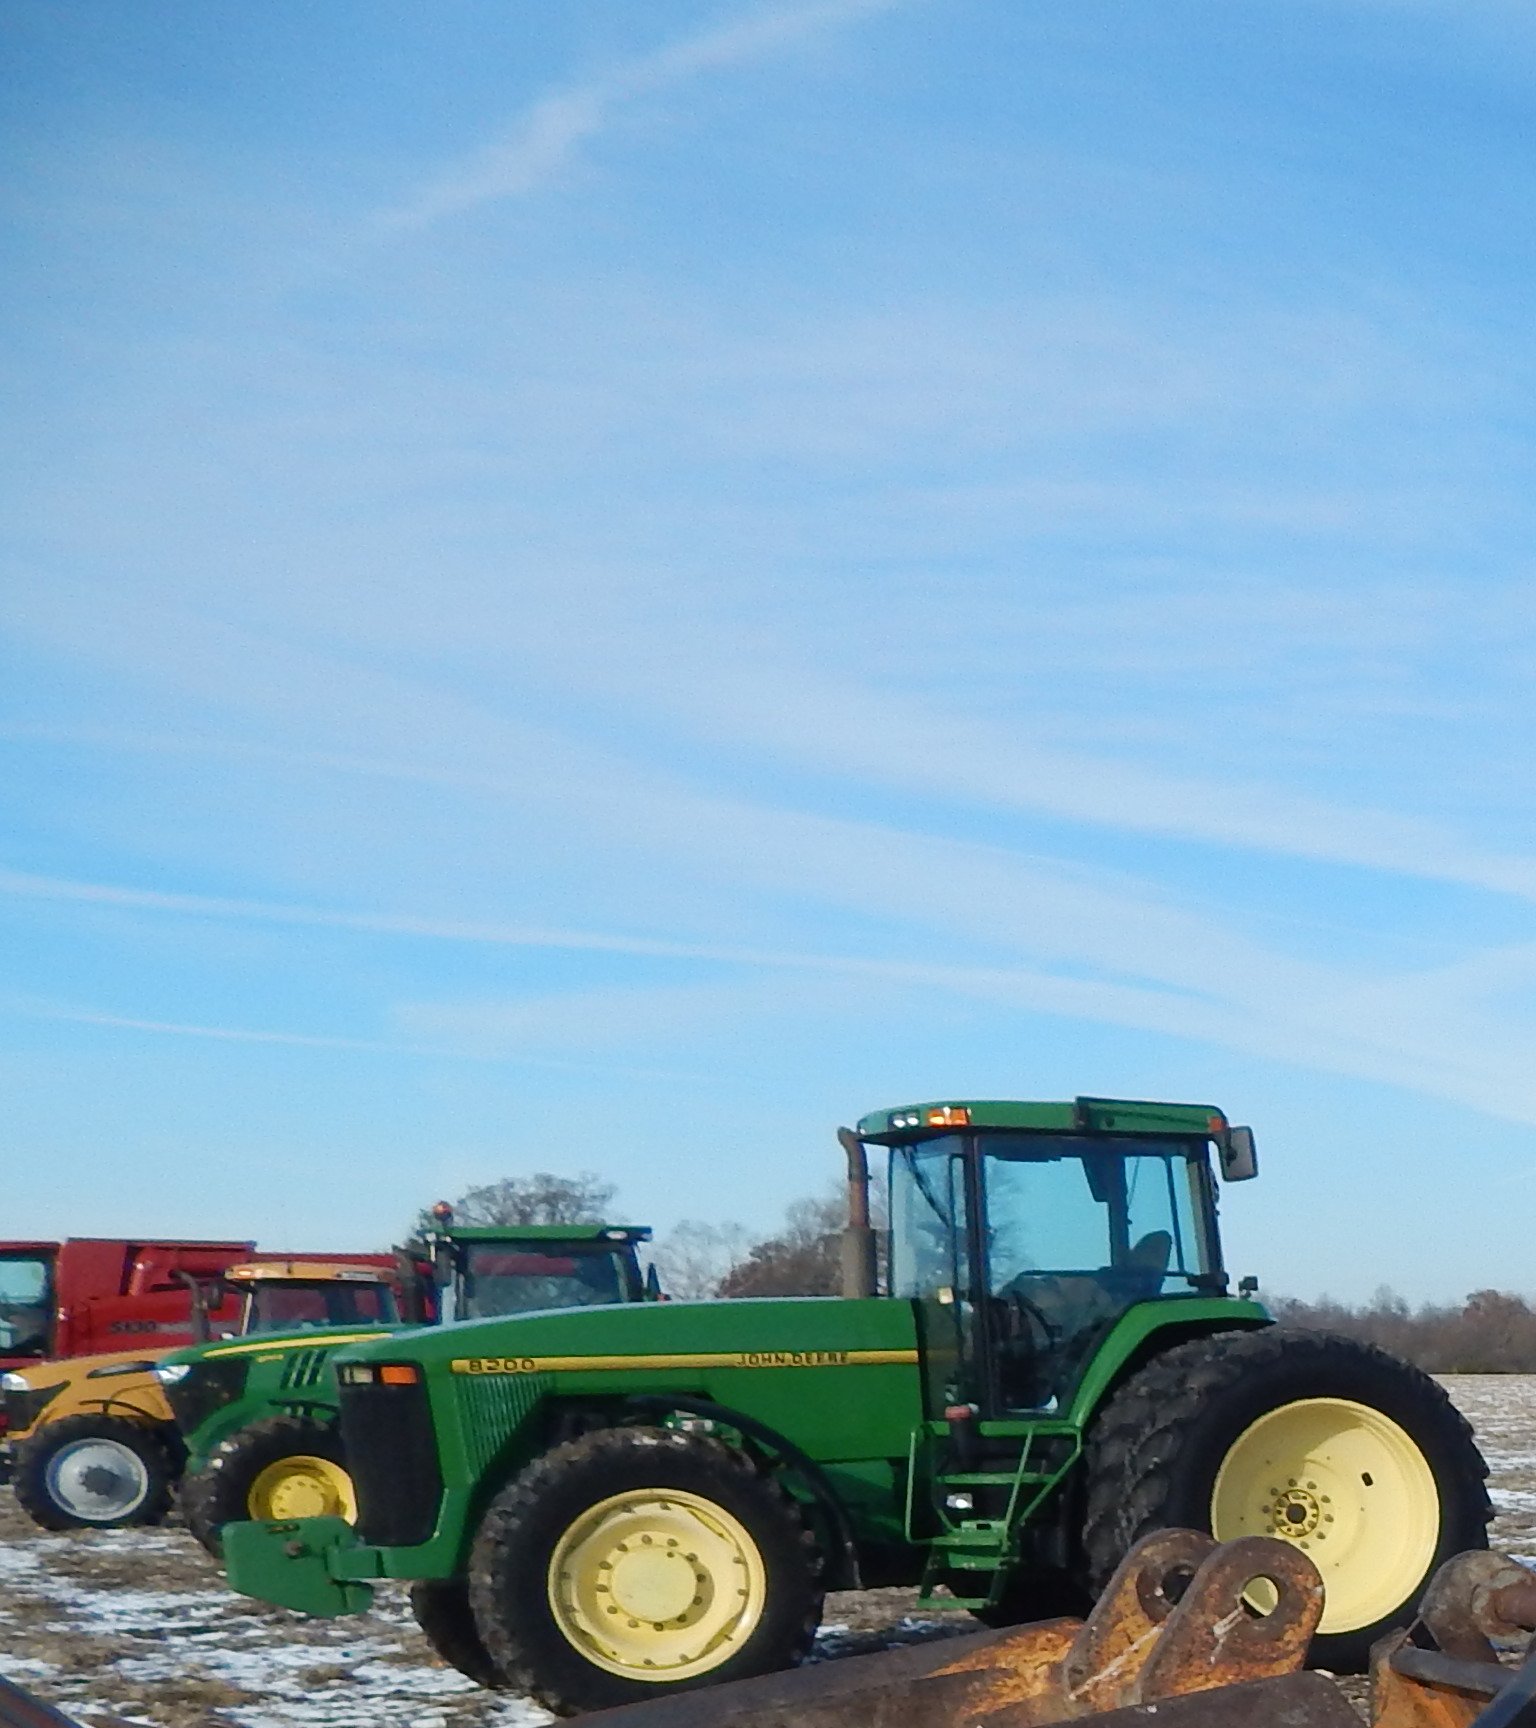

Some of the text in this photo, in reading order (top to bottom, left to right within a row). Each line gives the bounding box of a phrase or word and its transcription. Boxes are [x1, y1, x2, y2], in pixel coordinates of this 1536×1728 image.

[468, 1358, 535, 1372] 8200
[738, 1352, 848, 1366] JOHN DEERE
